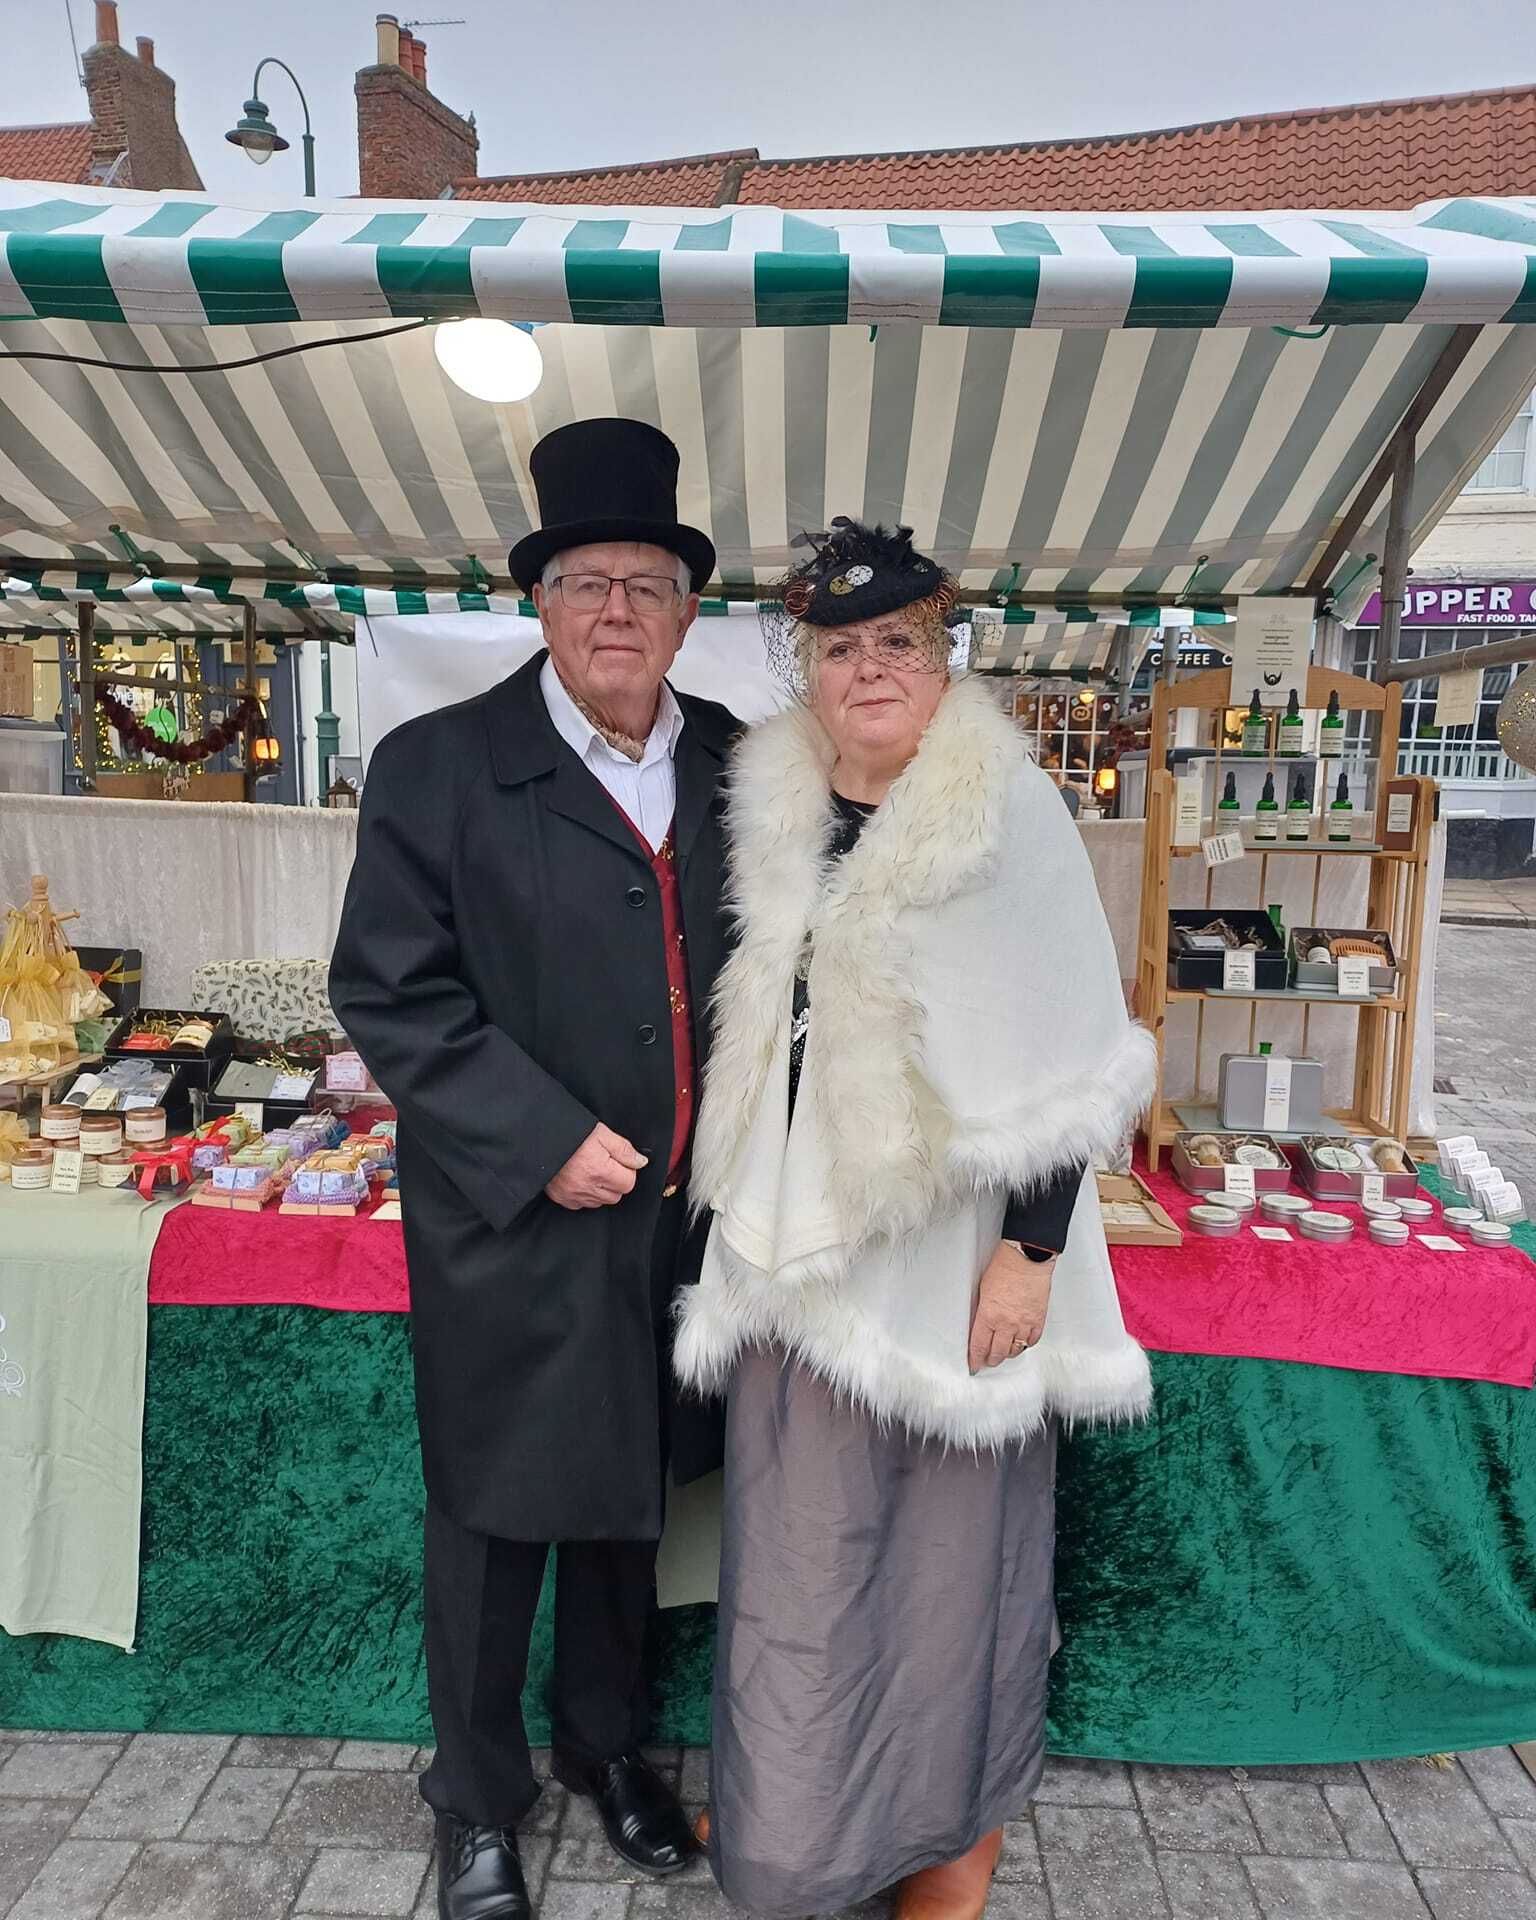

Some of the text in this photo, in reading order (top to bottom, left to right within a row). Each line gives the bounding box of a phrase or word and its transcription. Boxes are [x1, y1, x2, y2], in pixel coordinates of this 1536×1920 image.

[1457, 614, 1484, 623] FAST
[1486, 614, 1516, 623] FOOD
[1150, 653, 1210, 665] CFFEE
